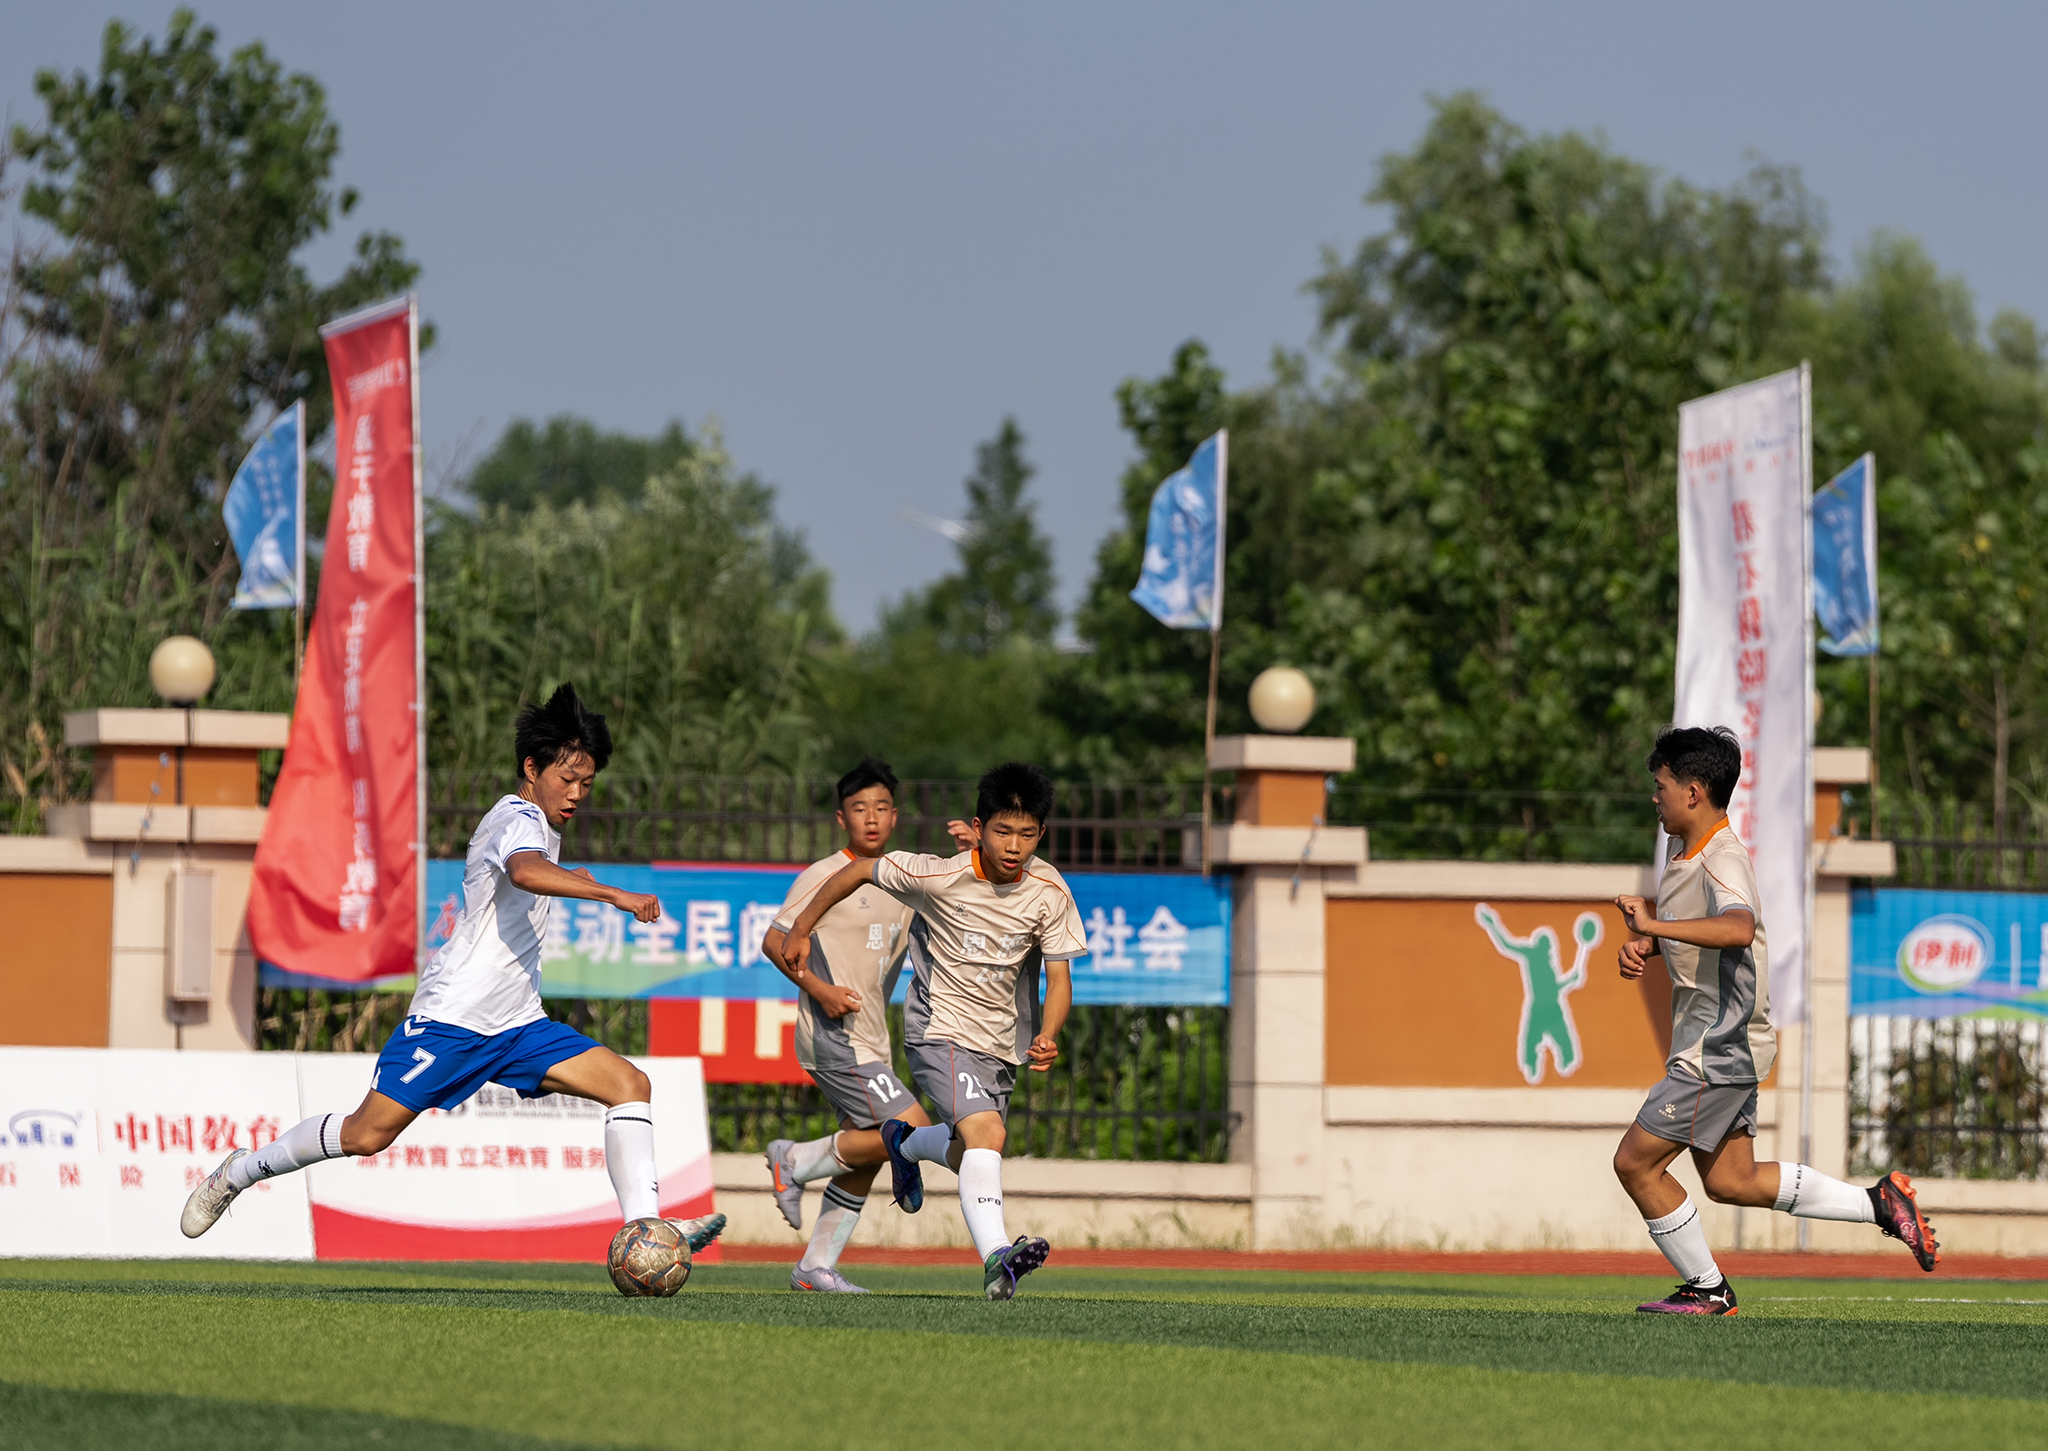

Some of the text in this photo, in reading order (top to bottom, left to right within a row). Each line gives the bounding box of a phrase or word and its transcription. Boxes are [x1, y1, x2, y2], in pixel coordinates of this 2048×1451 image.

[1085, 904, 1189, 974] 社会
[400, 1046, 436, 1085] 7
[867, 1073, 902, 1104] 12
[114, 1114, 281, 1152] 中国教育
[458, 1145, 548, 1169] 立足教育
